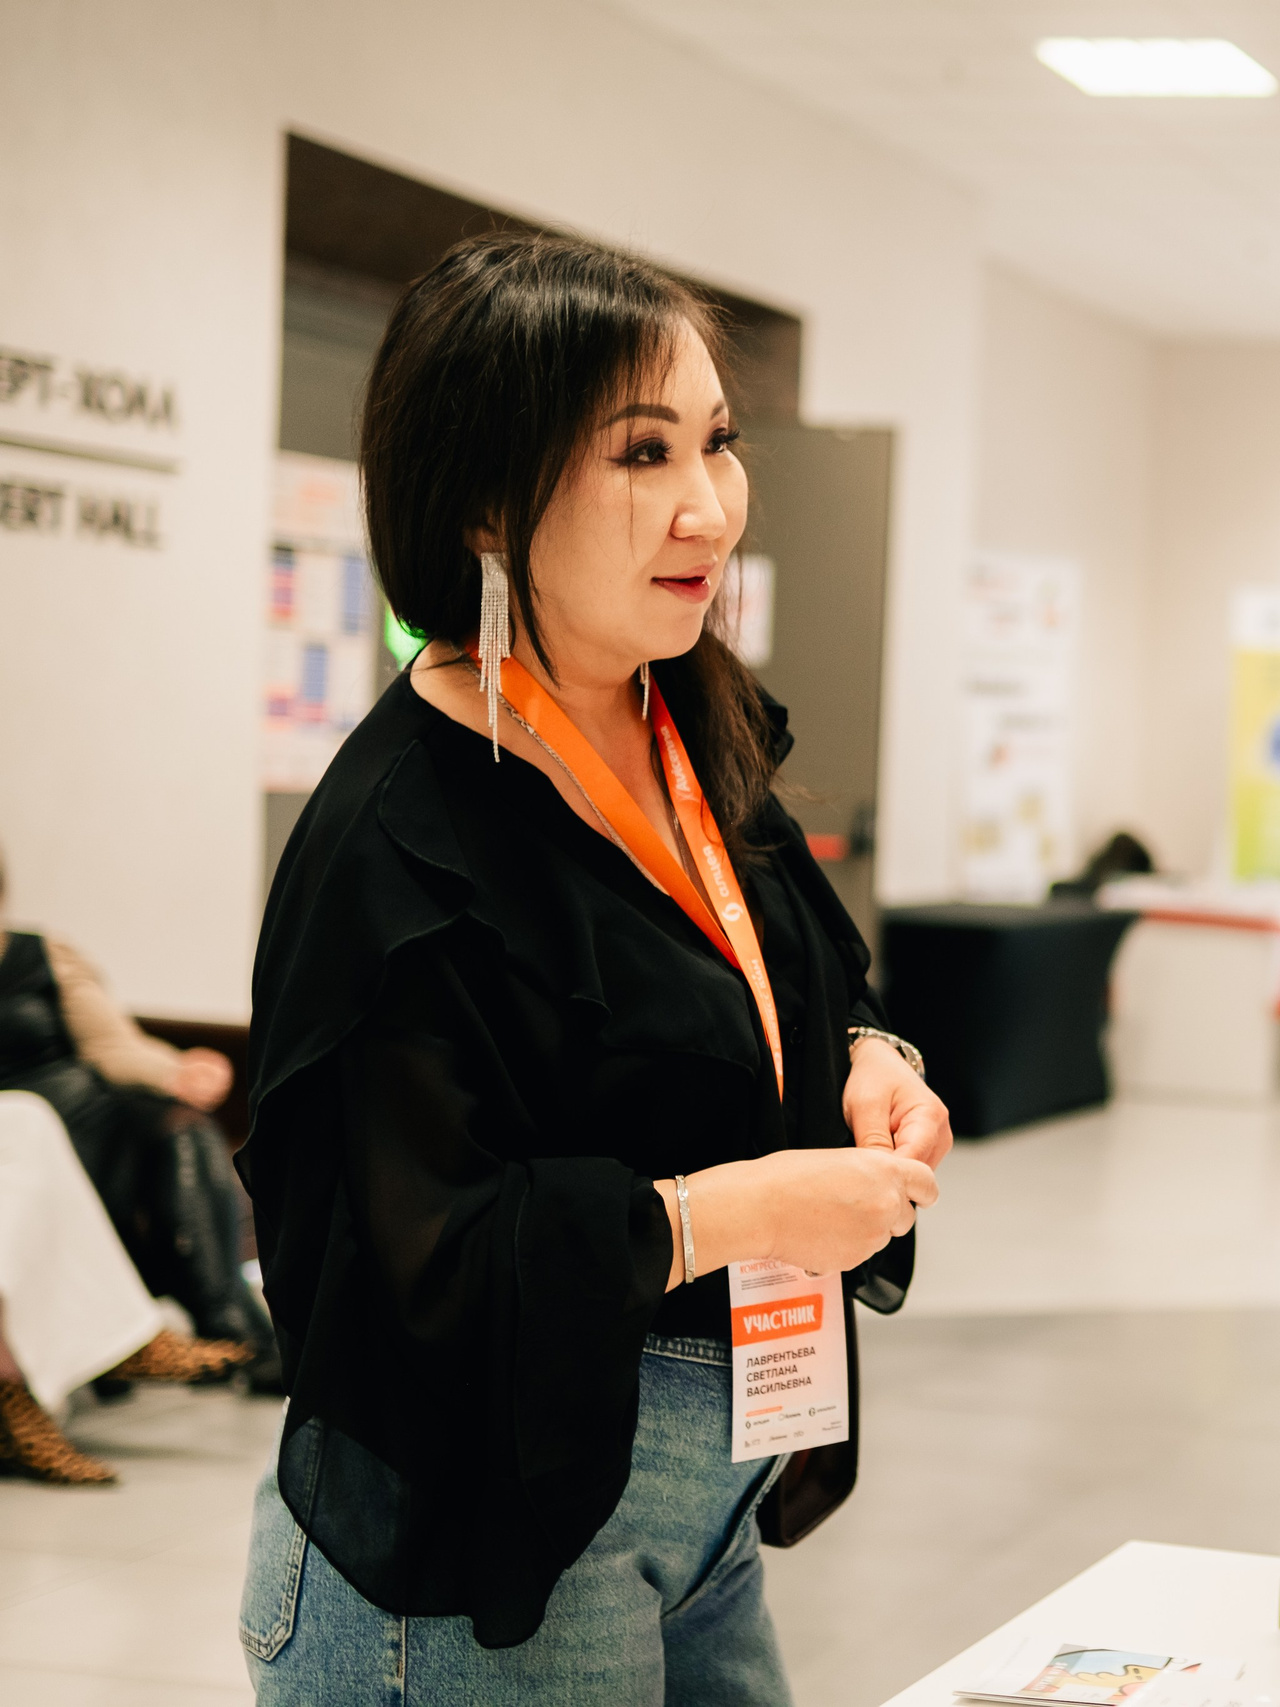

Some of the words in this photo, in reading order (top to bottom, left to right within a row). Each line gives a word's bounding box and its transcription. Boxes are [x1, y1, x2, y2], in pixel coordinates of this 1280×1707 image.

[77, 489, 161, 550] HALL
[744, 1305, 815, 1333] УЧАСТНИК
[746, 1346, 816, 1368] ЛАВРЕНТЬЕВА
[746, 1364, 798, 1383] СВЕТЛАНА
[746, 1376, 812, 1397] ВАСИЛЬЕВНА
